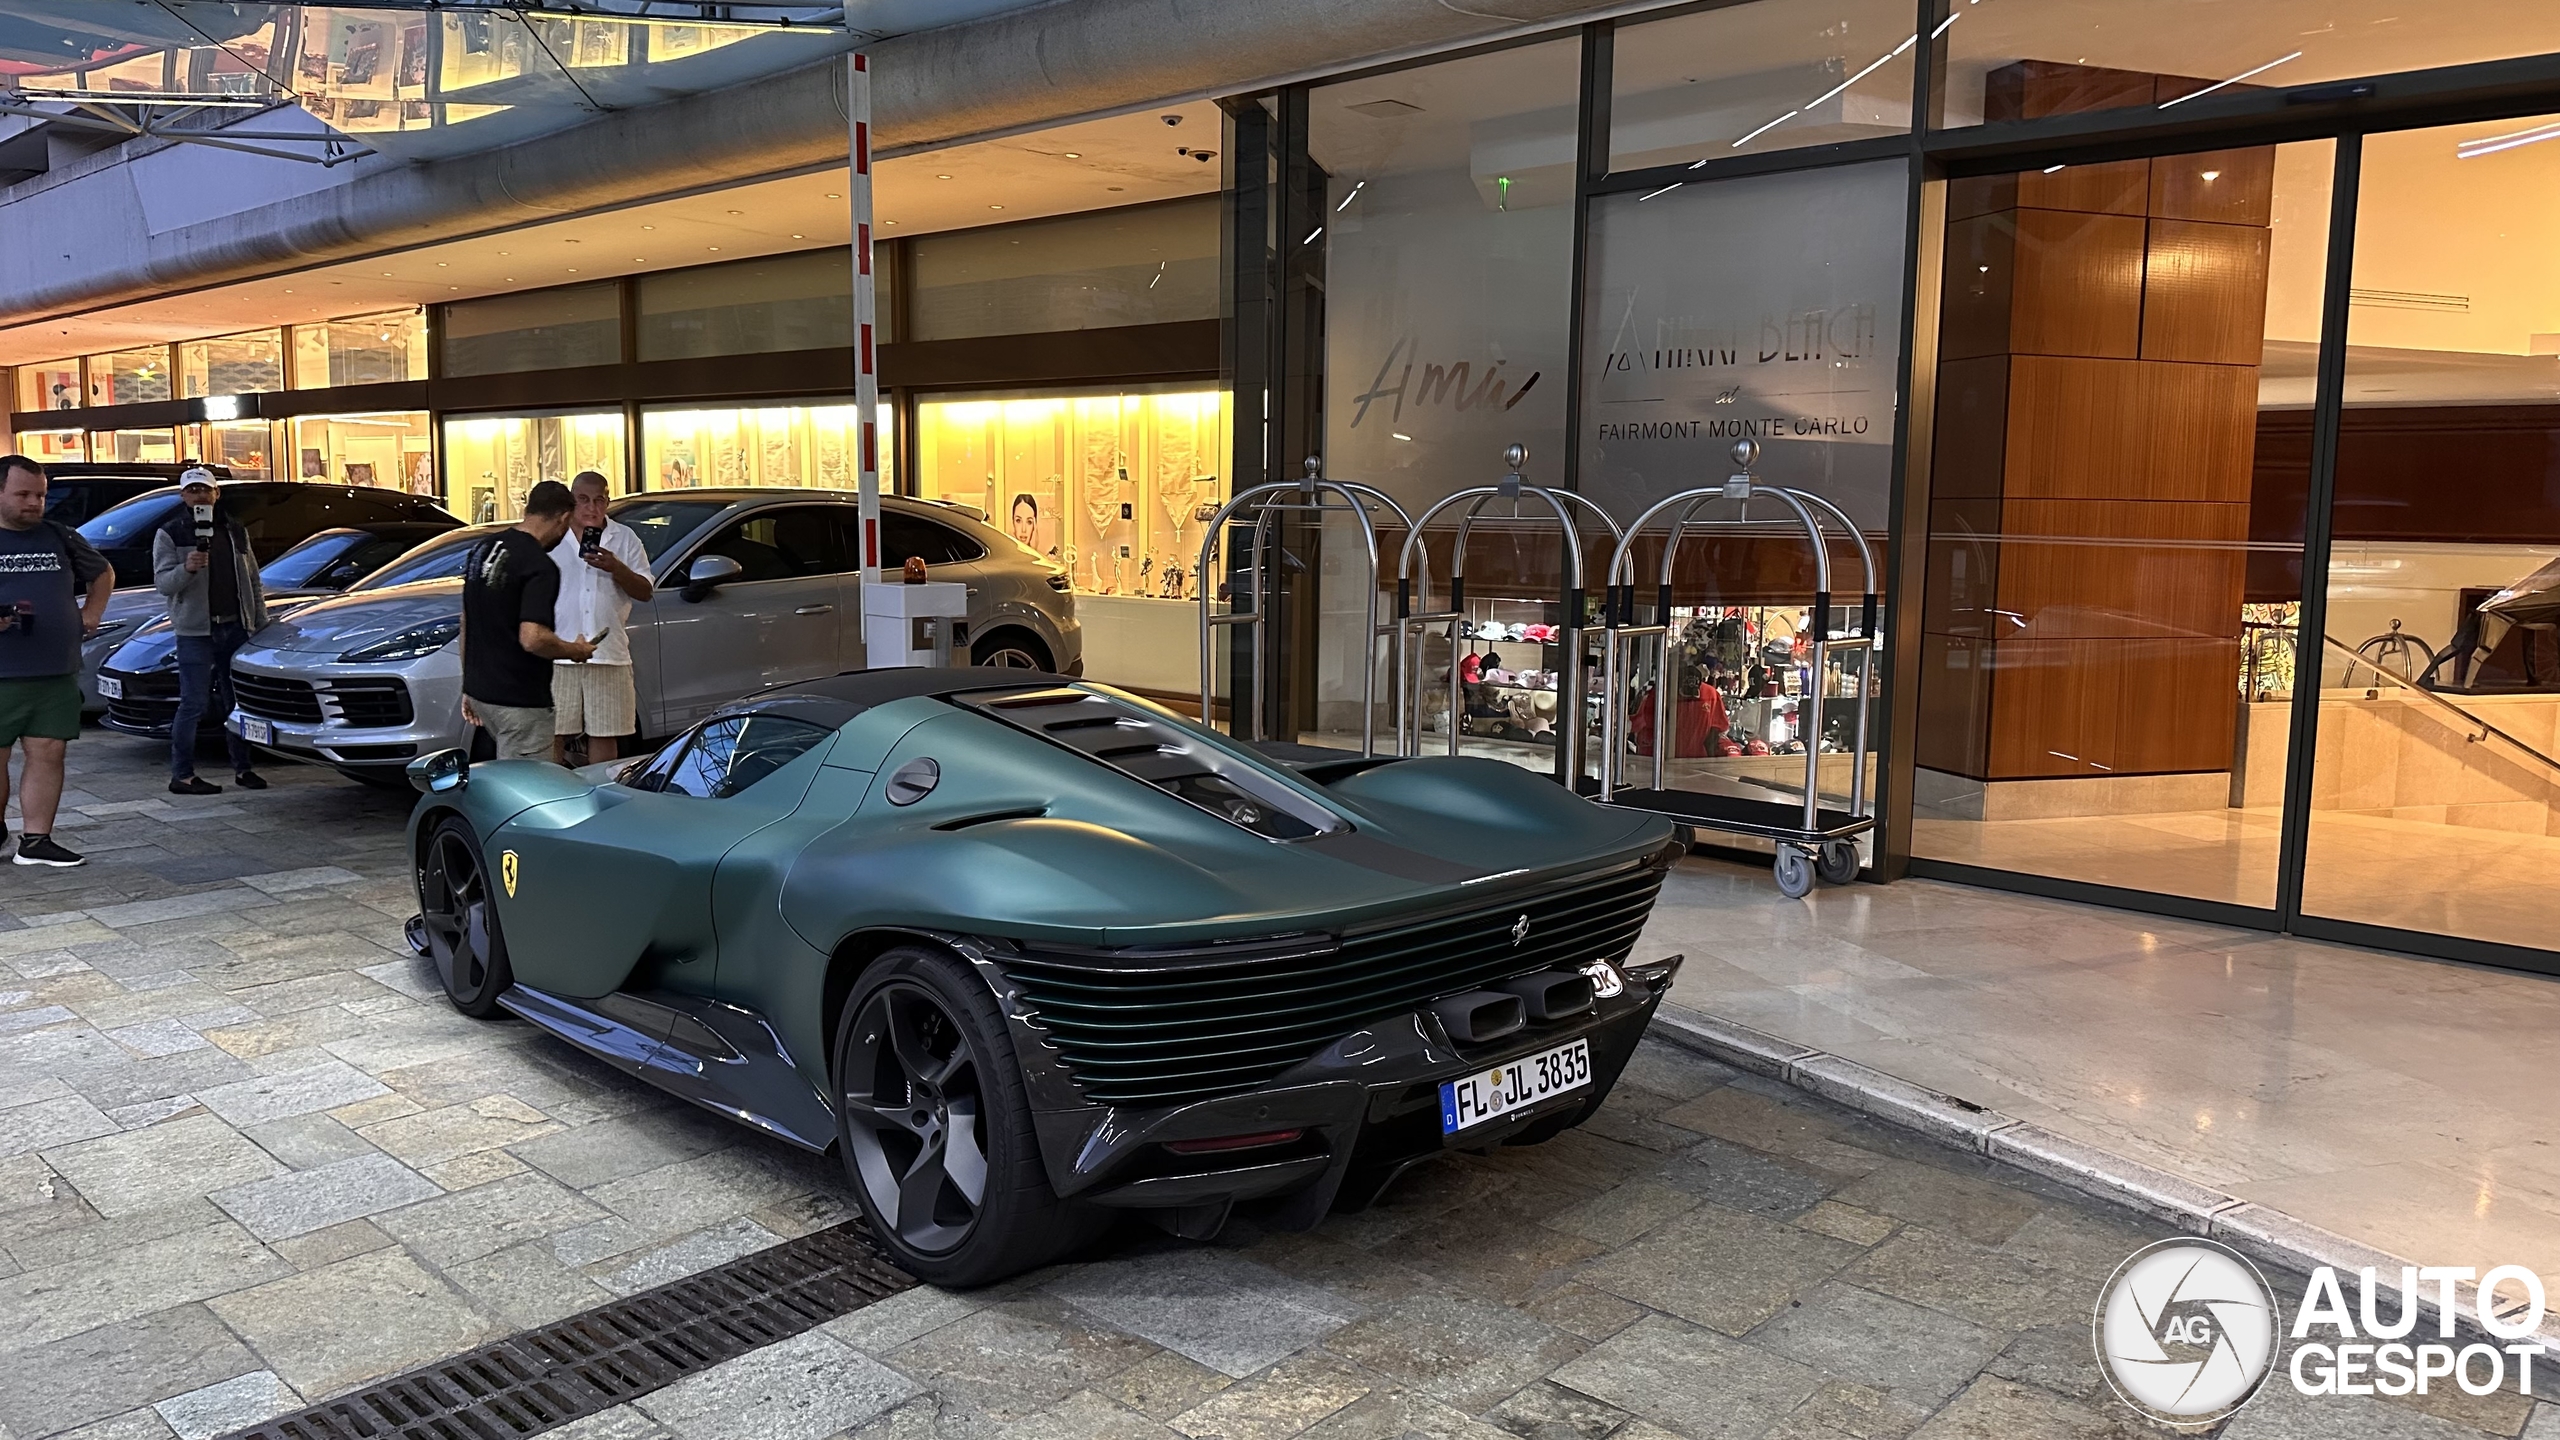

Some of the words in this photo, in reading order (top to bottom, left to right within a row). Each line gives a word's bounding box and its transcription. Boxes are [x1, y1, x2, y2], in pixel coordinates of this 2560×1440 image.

[1757, 303, 1877, 364] BEACH
[1715, 385, 1741, 404] at
[1599, 421, 1701, 441] FAIRMONT
[1709, 418, 1785, 438] MONTE
[1794, 415, 1869, 436] CARLO
[1591, 969, 1617, 992] DK
[1446, 1113, 1453, 1125] D
[1457, 1080, 1488, 1123] FL
[1505, 1065, 1532, 1105] JL
[1536, 1044, 1588, 1094] 3835
